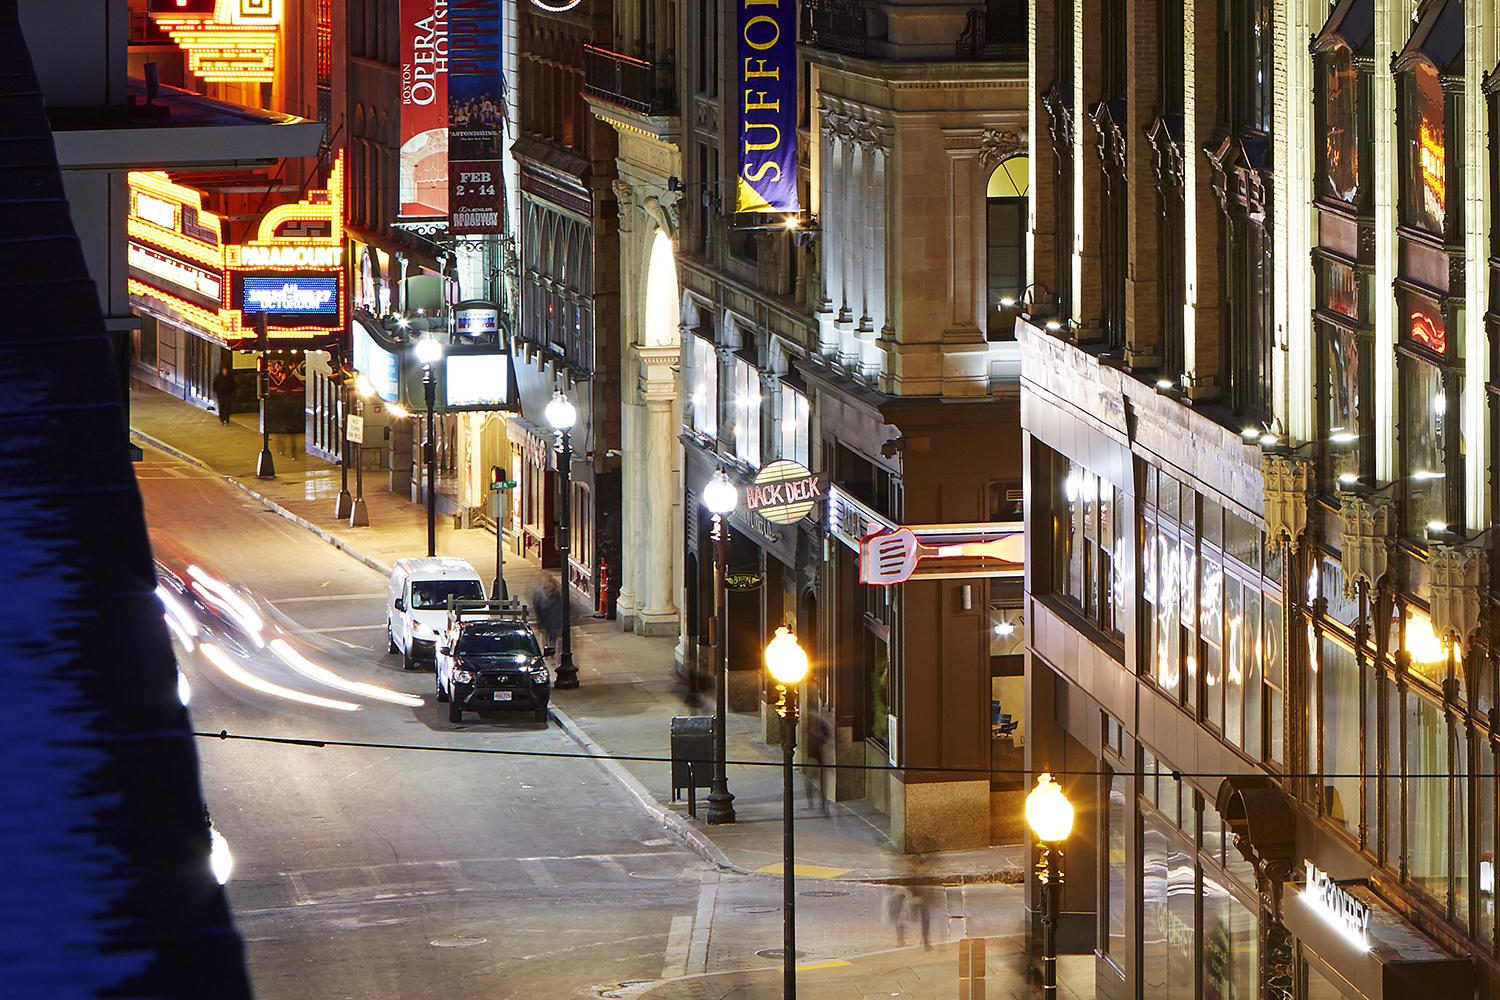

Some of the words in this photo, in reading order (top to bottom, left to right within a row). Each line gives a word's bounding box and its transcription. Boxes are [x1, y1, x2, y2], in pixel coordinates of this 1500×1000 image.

[411, 14, 435, 106] OPERA
[402, 63, 411, 105] BOSTON
[456, 185, 465, 196] 2
[478, 185, 495, 196] 14
[460, 172, 492, 183] FEB
[453, 212, 498, 221] BROADWAY
[241, 246, 344, 266] PARAMOUNT
[746, 484, 784, 509] BACK
[785, 476, 820, 503] DECK
[1324, 878, 1373, 950] GODFREY
